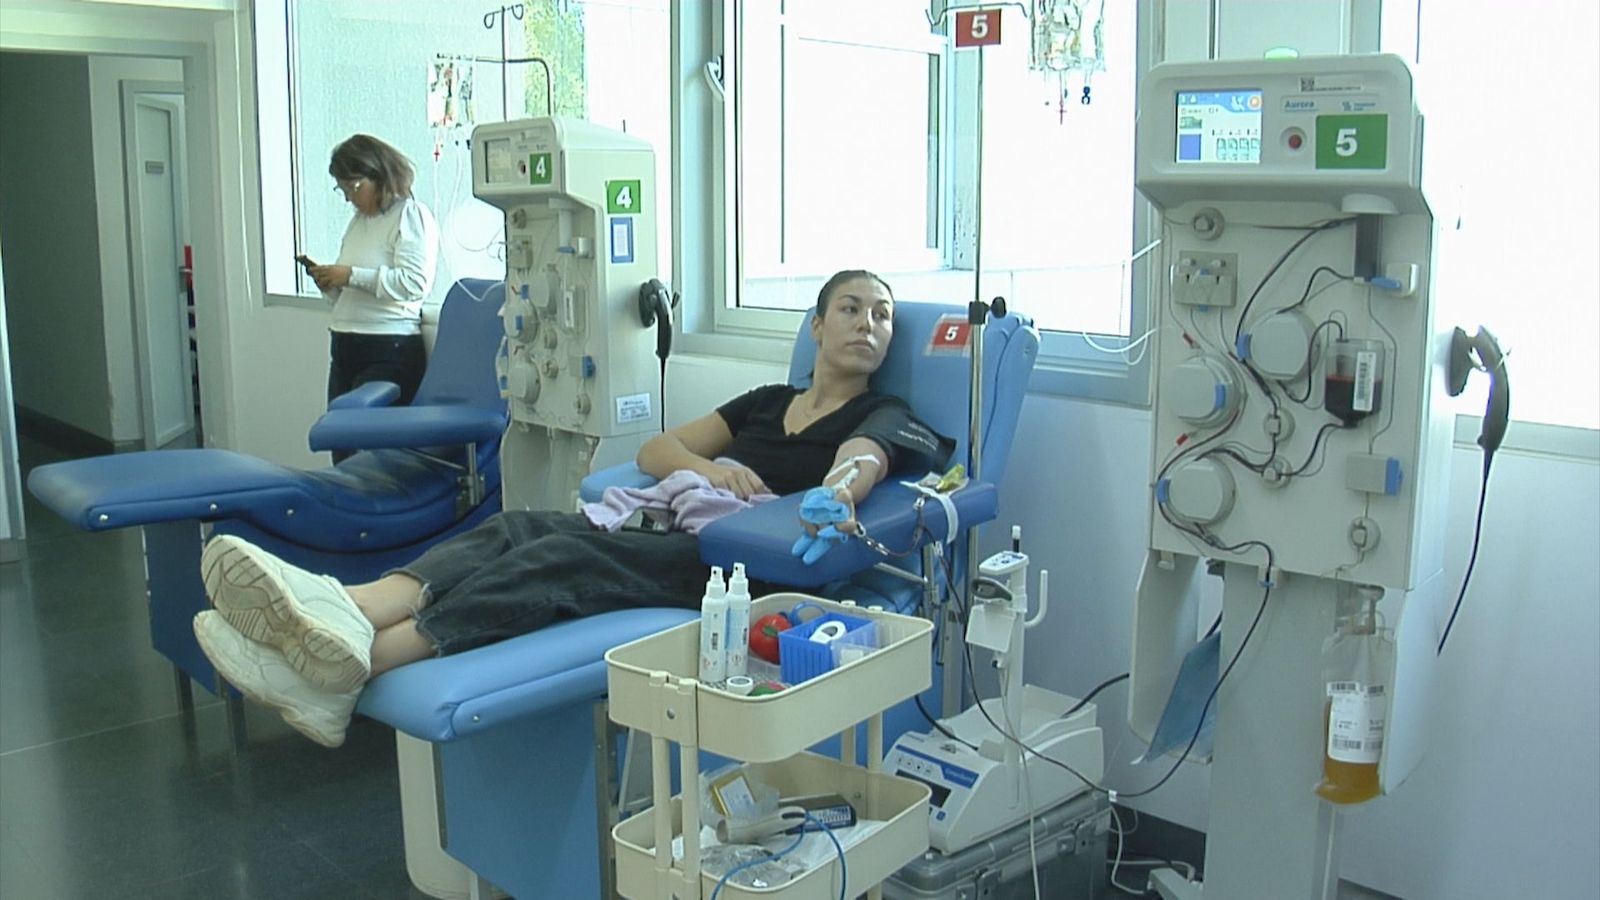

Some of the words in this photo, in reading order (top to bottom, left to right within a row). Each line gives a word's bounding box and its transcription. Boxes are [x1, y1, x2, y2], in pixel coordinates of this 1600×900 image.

[971, 14, 989, 38] 5
[1335, 128, 1358, 156] 5
[536, 156, 546, 178] 4
[616, 186, 632, 209] 4
[945, 326, 959, 341] 5
